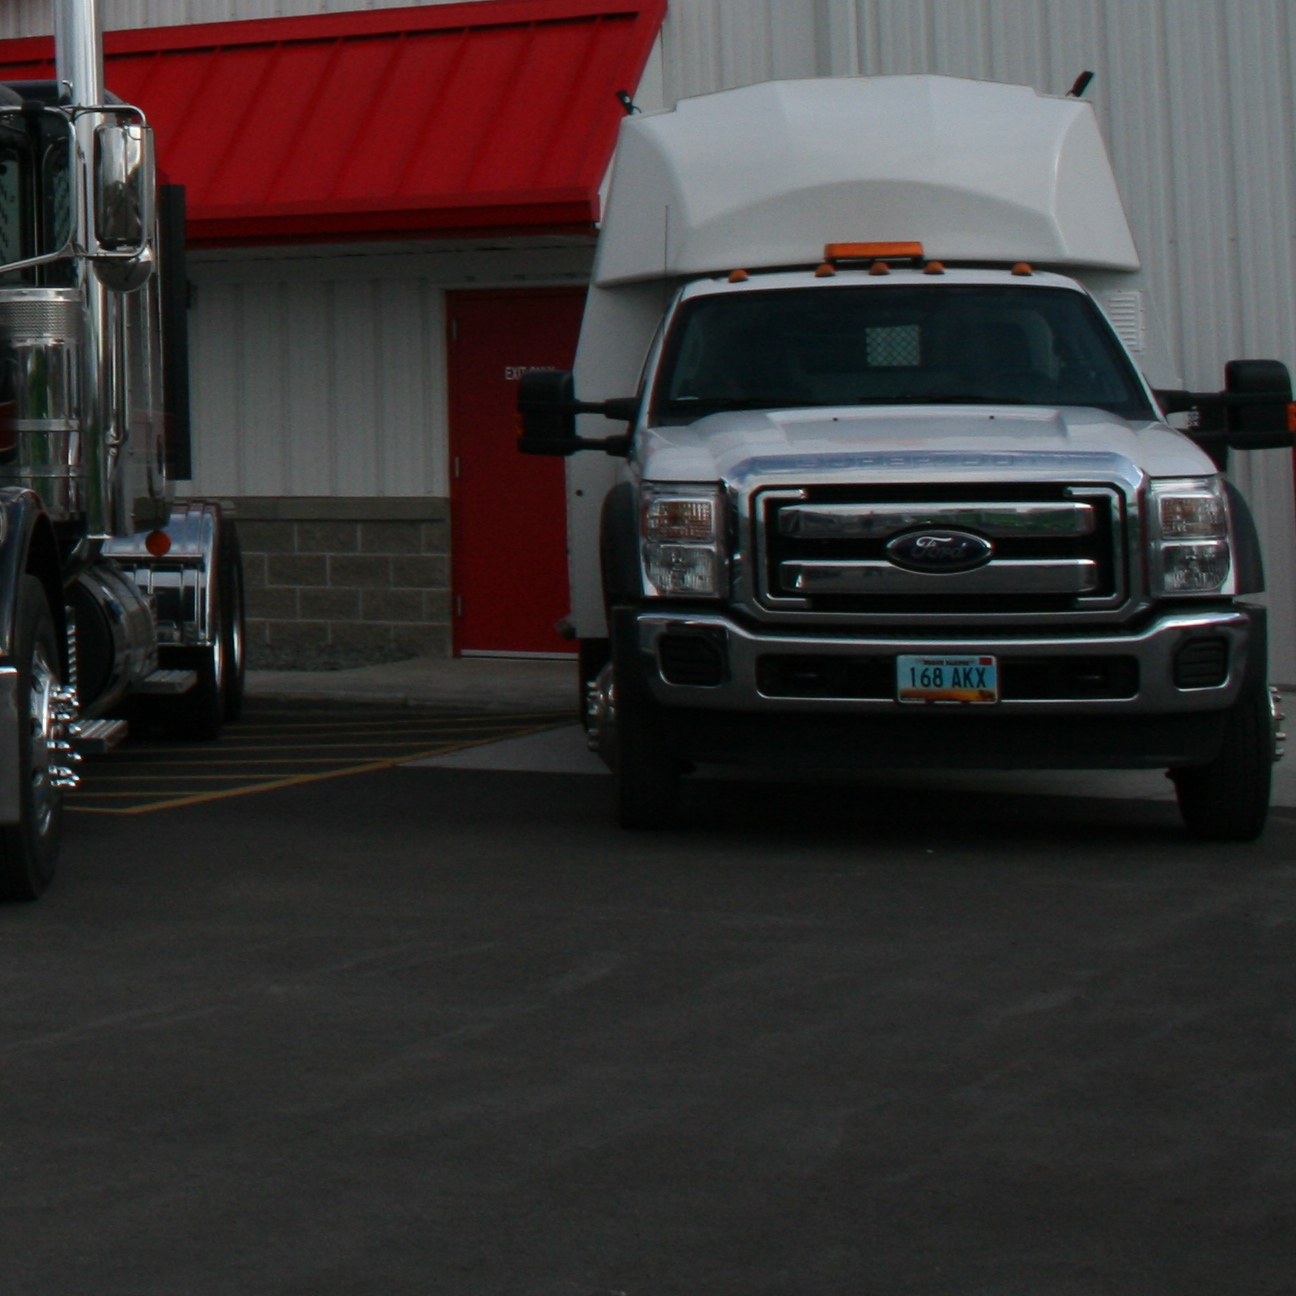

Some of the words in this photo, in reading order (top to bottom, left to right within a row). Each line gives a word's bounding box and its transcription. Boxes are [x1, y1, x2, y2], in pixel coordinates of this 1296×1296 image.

[911, 536, 968, 558] Ford
[910, 667, 943, 688] 168
[952, 667, 987, 689] AKX
